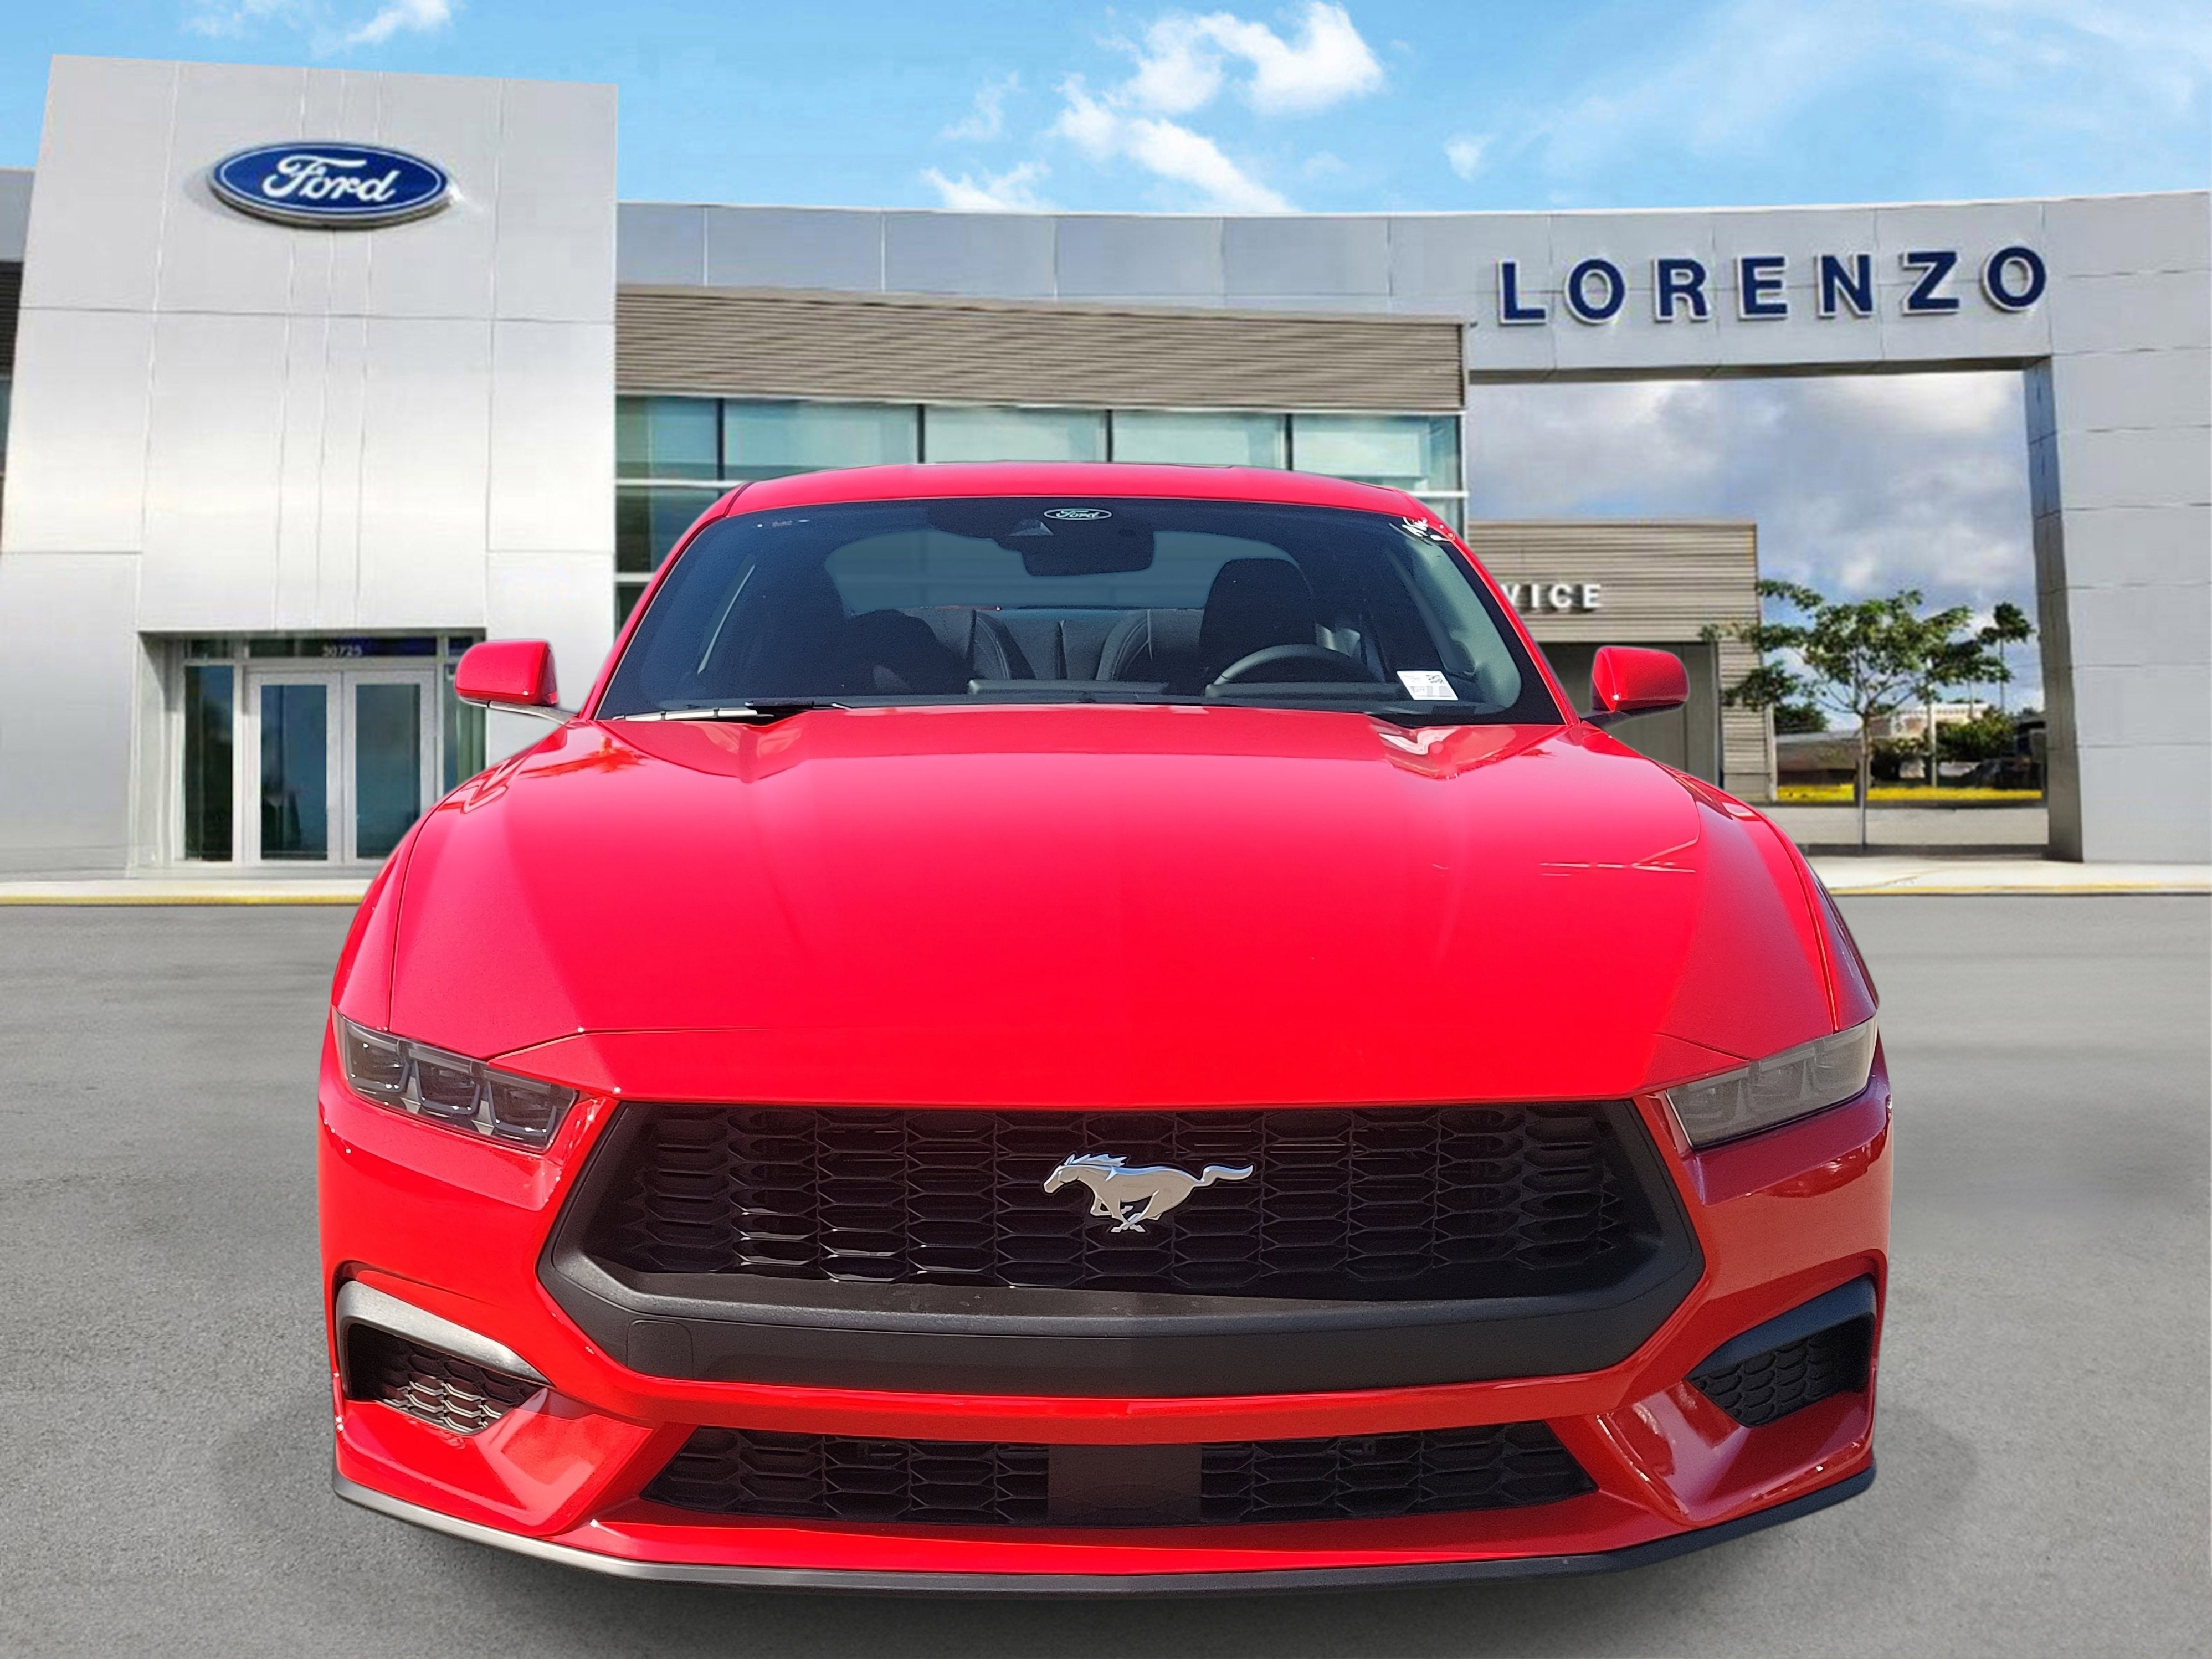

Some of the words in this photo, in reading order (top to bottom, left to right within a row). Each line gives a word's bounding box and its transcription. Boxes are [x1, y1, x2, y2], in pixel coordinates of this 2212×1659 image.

[262, 154, 401, 202] Ford
[1498, 246, 2048, 324] LORENZO
[1056, 509, 1100, 518] Ford
